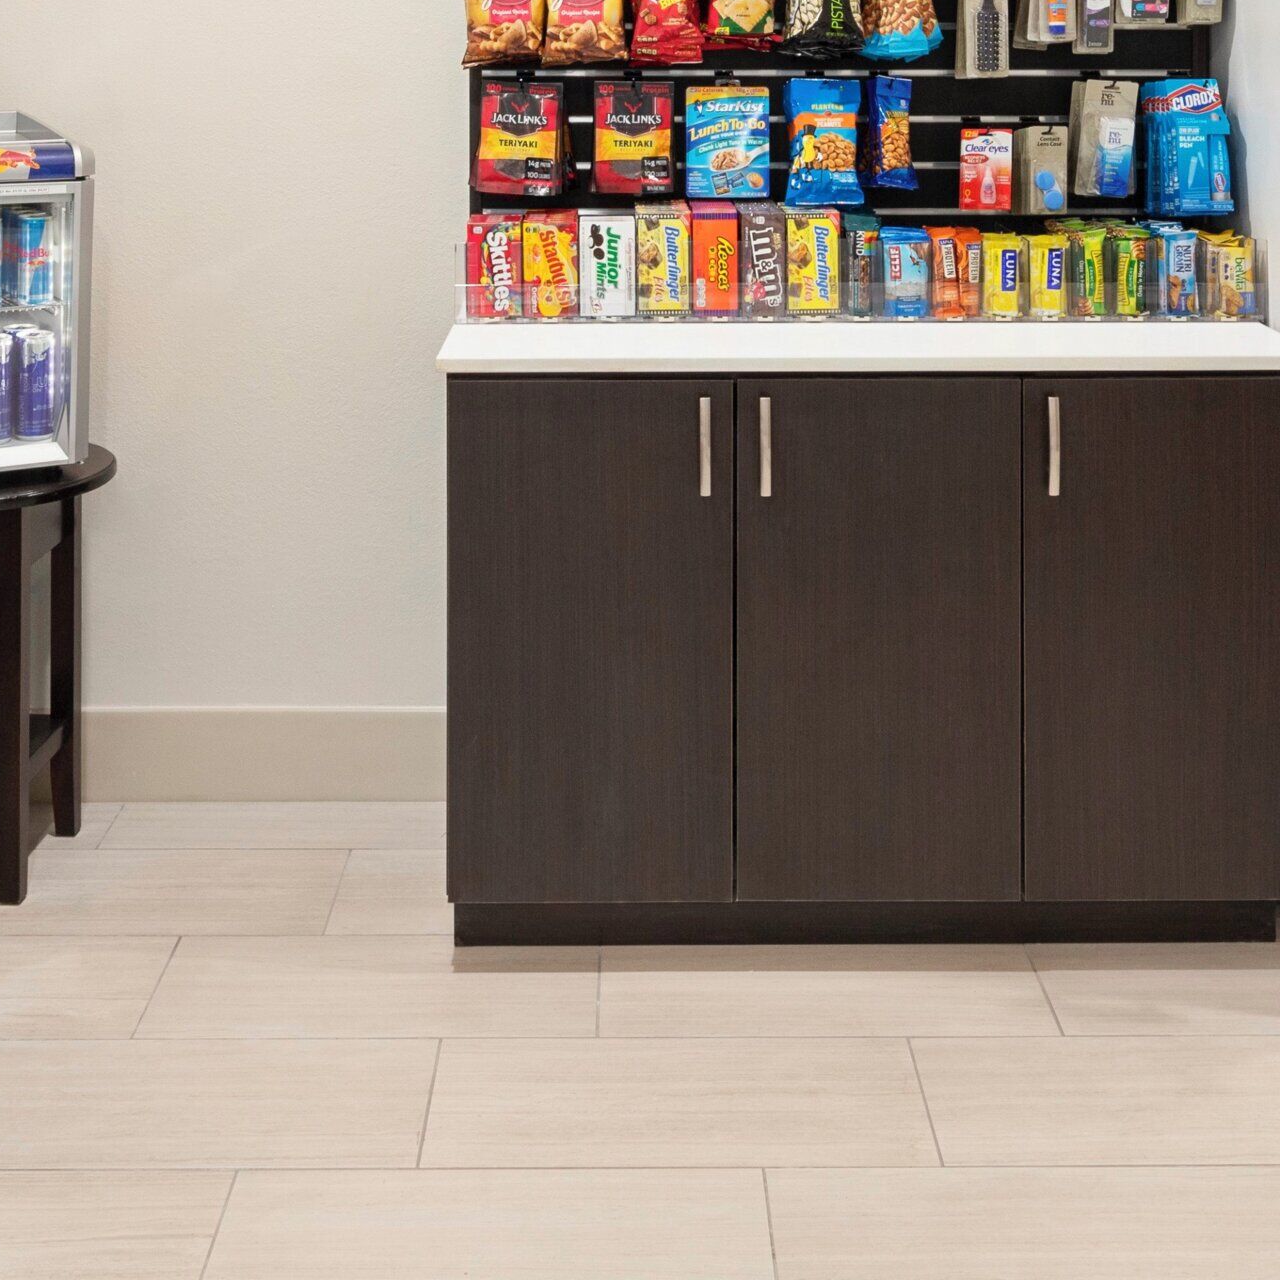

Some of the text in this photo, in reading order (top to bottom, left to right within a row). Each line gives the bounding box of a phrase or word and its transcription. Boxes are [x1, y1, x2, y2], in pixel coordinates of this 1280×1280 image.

[705, 100, 764, 113] StarKist
[1172, 89, 1217, 112] CLOROX
[491, 113, 516, 124] JACK
[605, 113, 631, 124] JACK
[690, 119, 729, 141] Lunch
[499, 139, 538, 148] TERIYAKI
[614, 140, 653, 148] TERIYAKI
[965, 144, 1008, 153] Clear eyes
[856, 230, 864, 256] KIND
[486, 231, 509, 312] Skittles
[606, 227, 622, 289] Junior
[664, 226, 681, 302] Butterfinger
[718, 237, 734, 292] Reese's
[815, 226, 830, 301] Butterfinger
[1003, 252, 1016, 288] LUNA
[1050, 250, 1062, 286] LUNA
[1174, 245, 1184, 273] GRAIN
[1184, 245, 1192, 272] NUTRI
[596, 261, 605, 300] Mints
[1235, 257, 1245, 290] belVita
